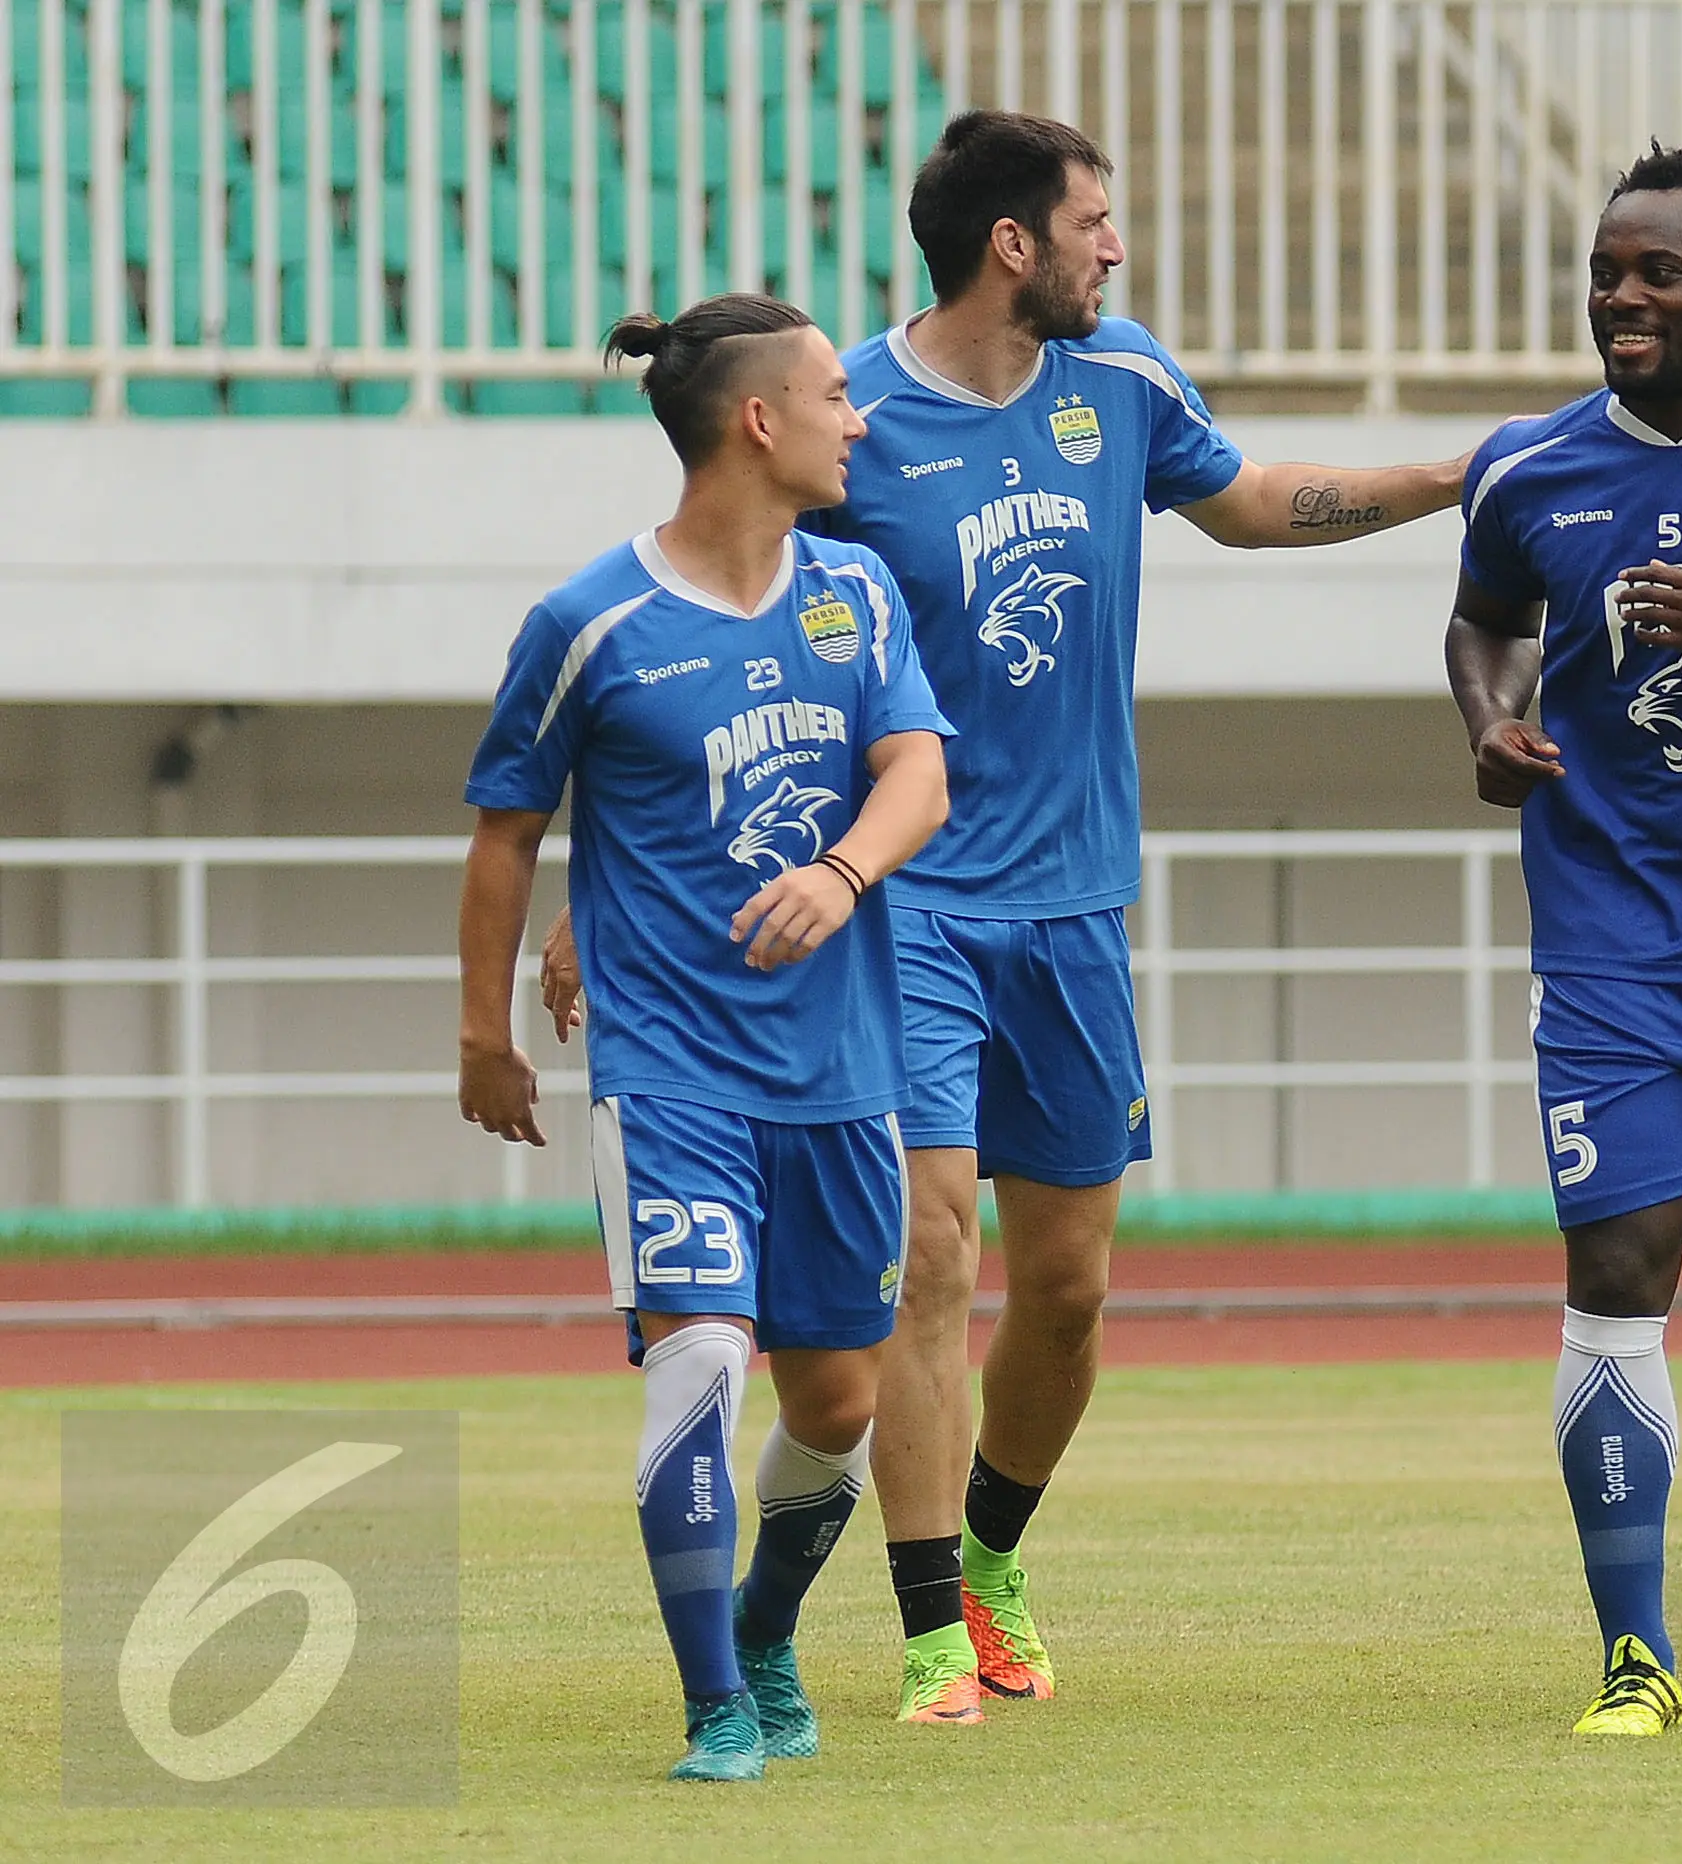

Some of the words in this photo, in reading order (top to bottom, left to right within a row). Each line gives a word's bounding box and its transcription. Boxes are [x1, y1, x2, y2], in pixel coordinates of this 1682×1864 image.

[900, 455, 964, 481] Sportama
[1003, 457, 1021, 486] 3
[1290, 486, 1383, 529] Luna
[1551, 507, 1614, 529] Sportama
[955, 488, 1092, 611] PANTHER
[1657, 513, 1682, 549] 5
[991, 536, 1066, 577] ENERGY
[633, 656, 711, 685] Sportama
[744, 657, 783, 692] 23
[703, 697, 848, 829] PANTHER
[743, 748, 823, 792] ENERGY
[1548, 1099, 1599, 1188] 5
[636, 1199, 743, 1285] 23
[685, 1455, 720, 1525] Sportama
[1602, 1434, 1635, 1507] Sportama
